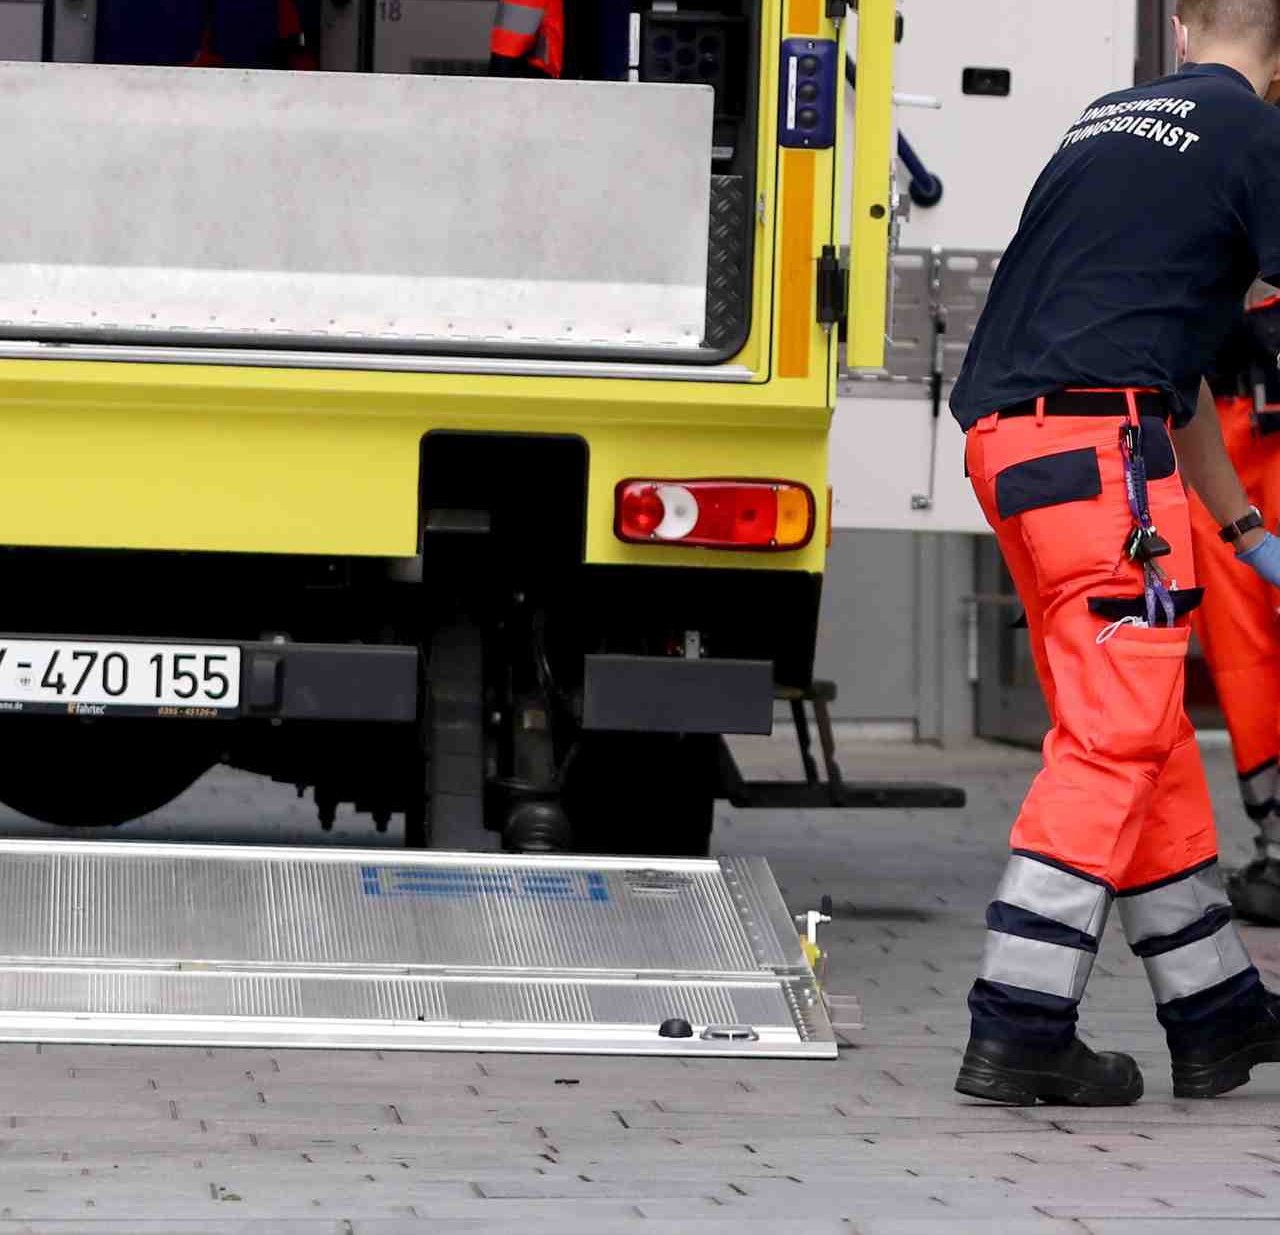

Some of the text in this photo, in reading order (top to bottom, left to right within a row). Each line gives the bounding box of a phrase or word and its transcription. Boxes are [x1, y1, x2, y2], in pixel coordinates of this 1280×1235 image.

[380, 0, 401, 22] 18
[1075, 97, 1195, 125] UNDESWEHR
[1063, 115, 1199, 152] TUNGSDIENST
[149, 653, 229, 700] 155
[76, 702, 105, 715] fahrtec
